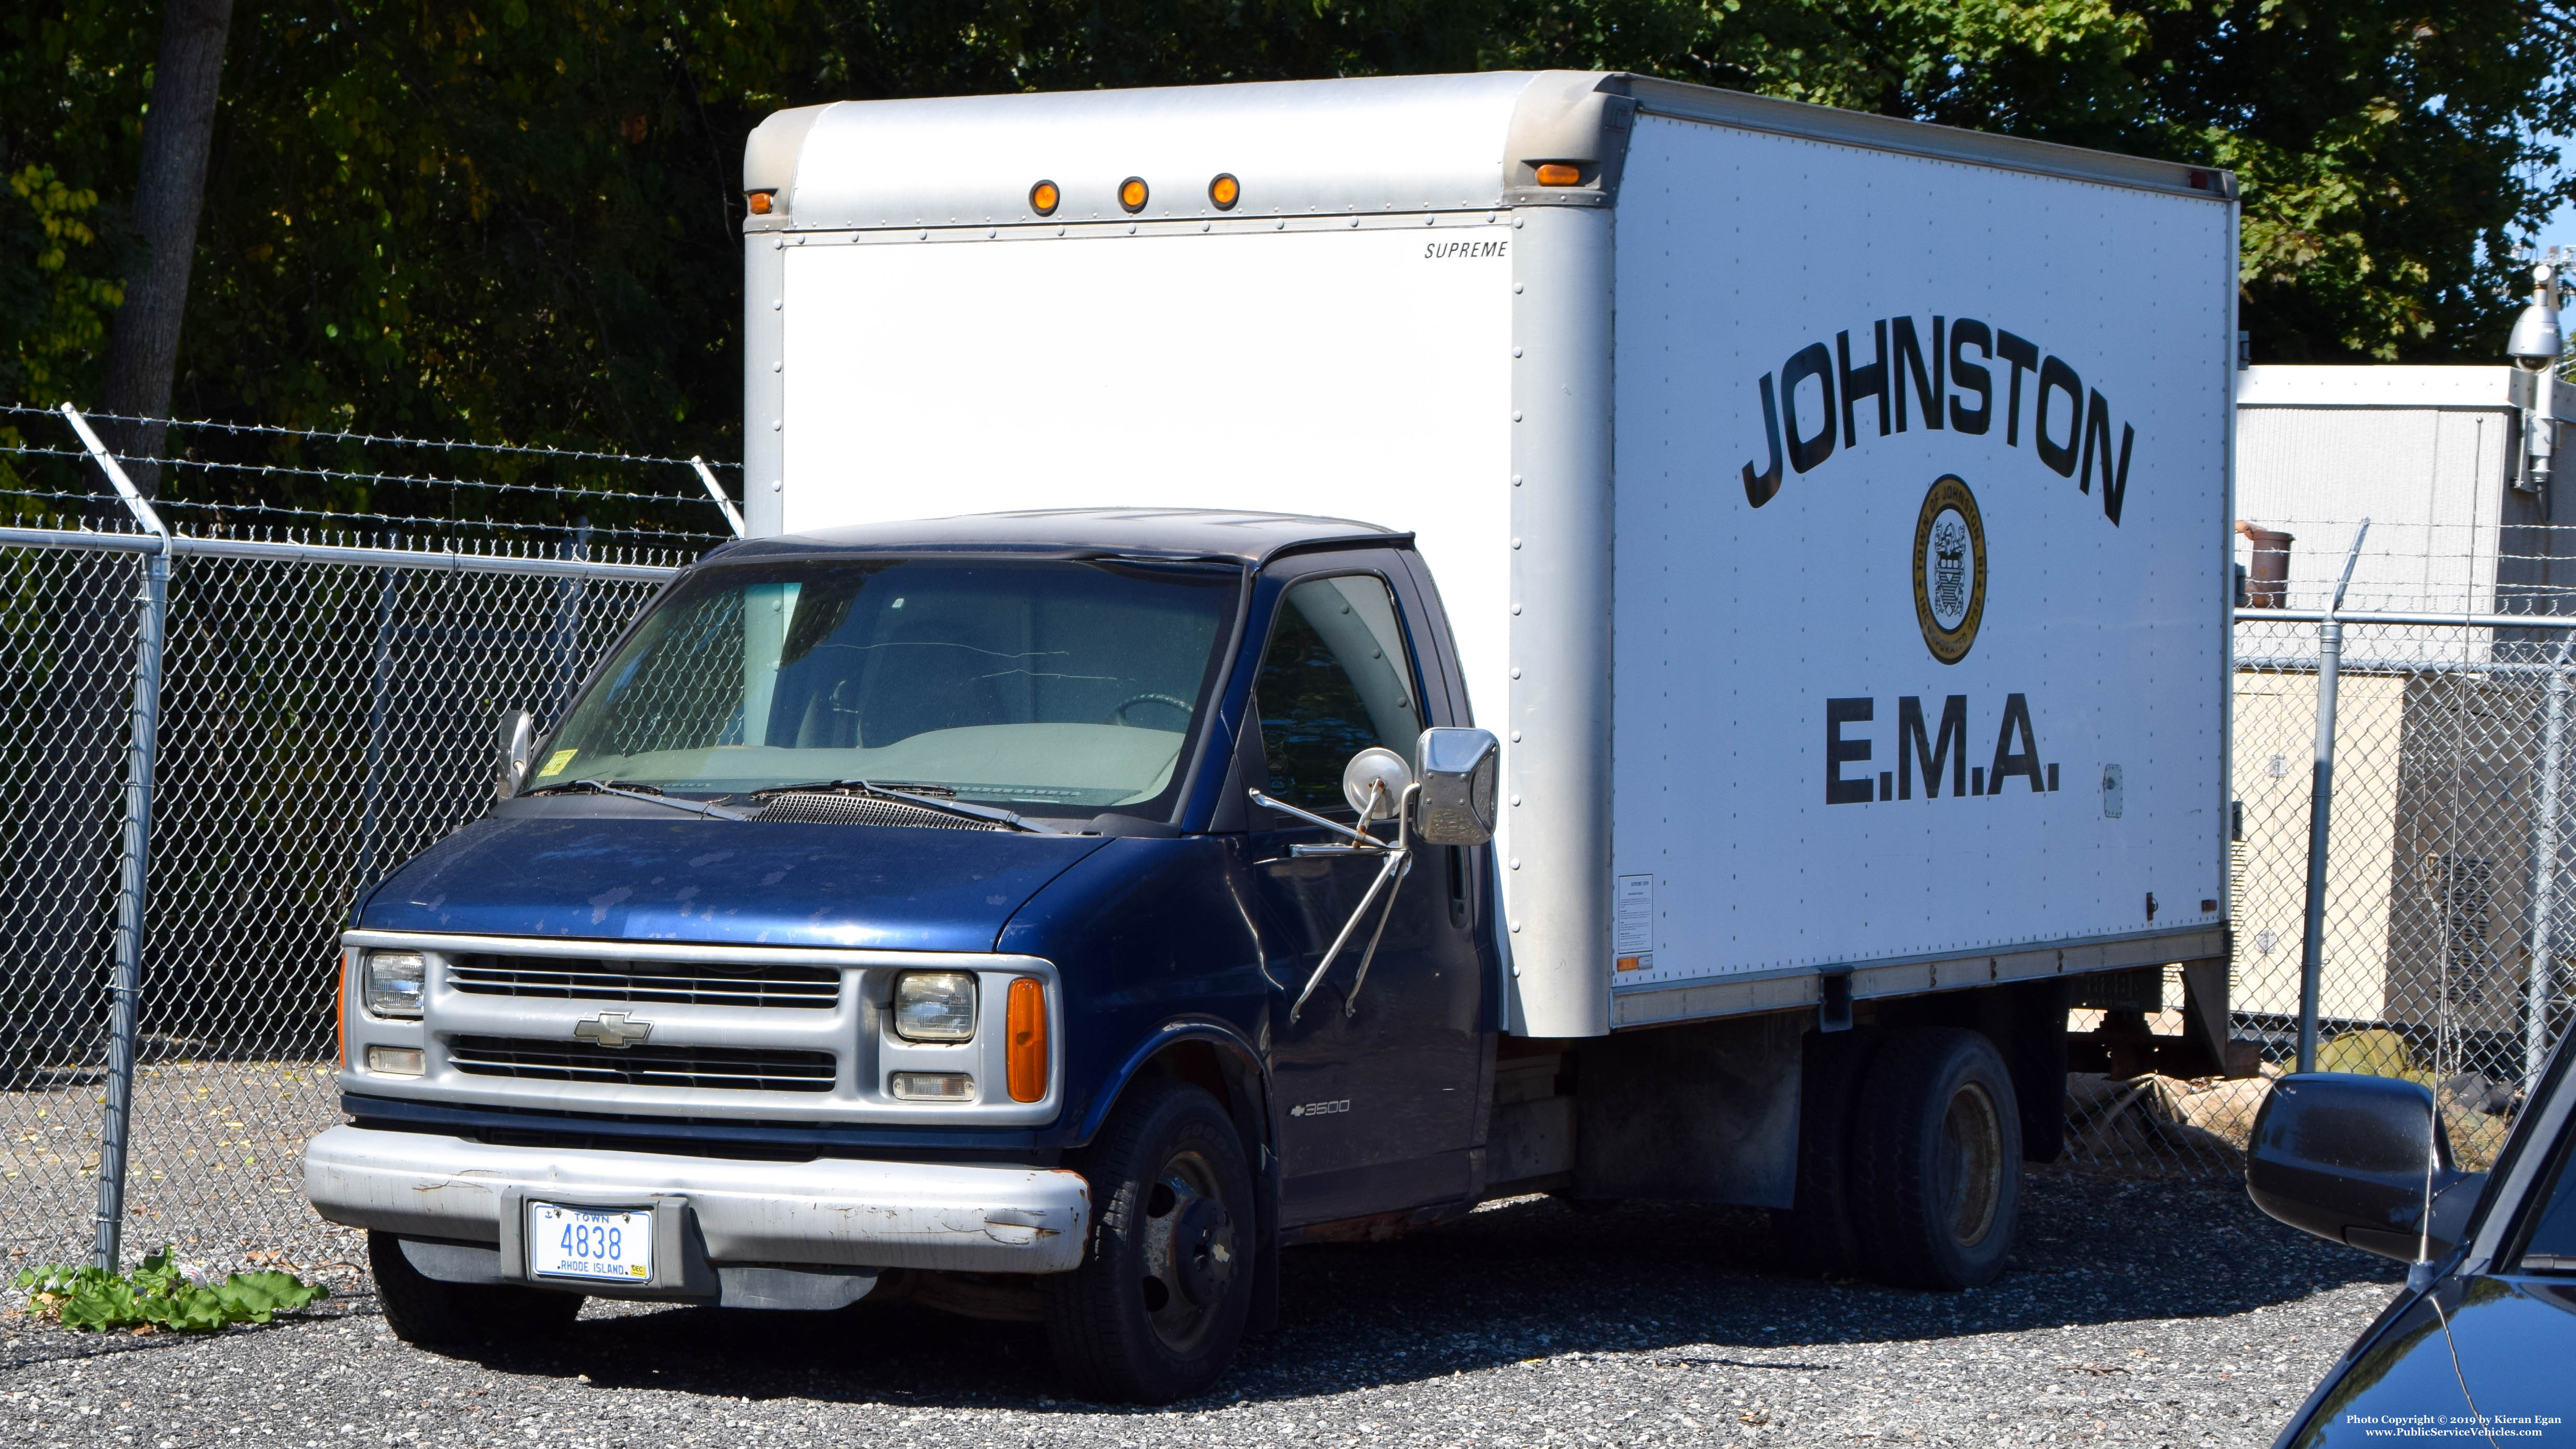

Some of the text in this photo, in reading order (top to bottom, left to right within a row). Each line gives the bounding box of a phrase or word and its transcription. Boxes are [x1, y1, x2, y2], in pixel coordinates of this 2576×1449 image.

[1424, 241, 1508, 259] SUPREME
[1741, 314, 2135, 529] JOHNSTON
[1929, 491, 1939, 513] OF
[1825, 693, 2059, 805] E.M.A.
[1305, 1099, 1350, 1116] 3500
[574, 1213, 610, 1223] TOWN
[560, 1223, 622, 1260] 4838
[561, 1260, 624, 1275] RHODE ISLAND
